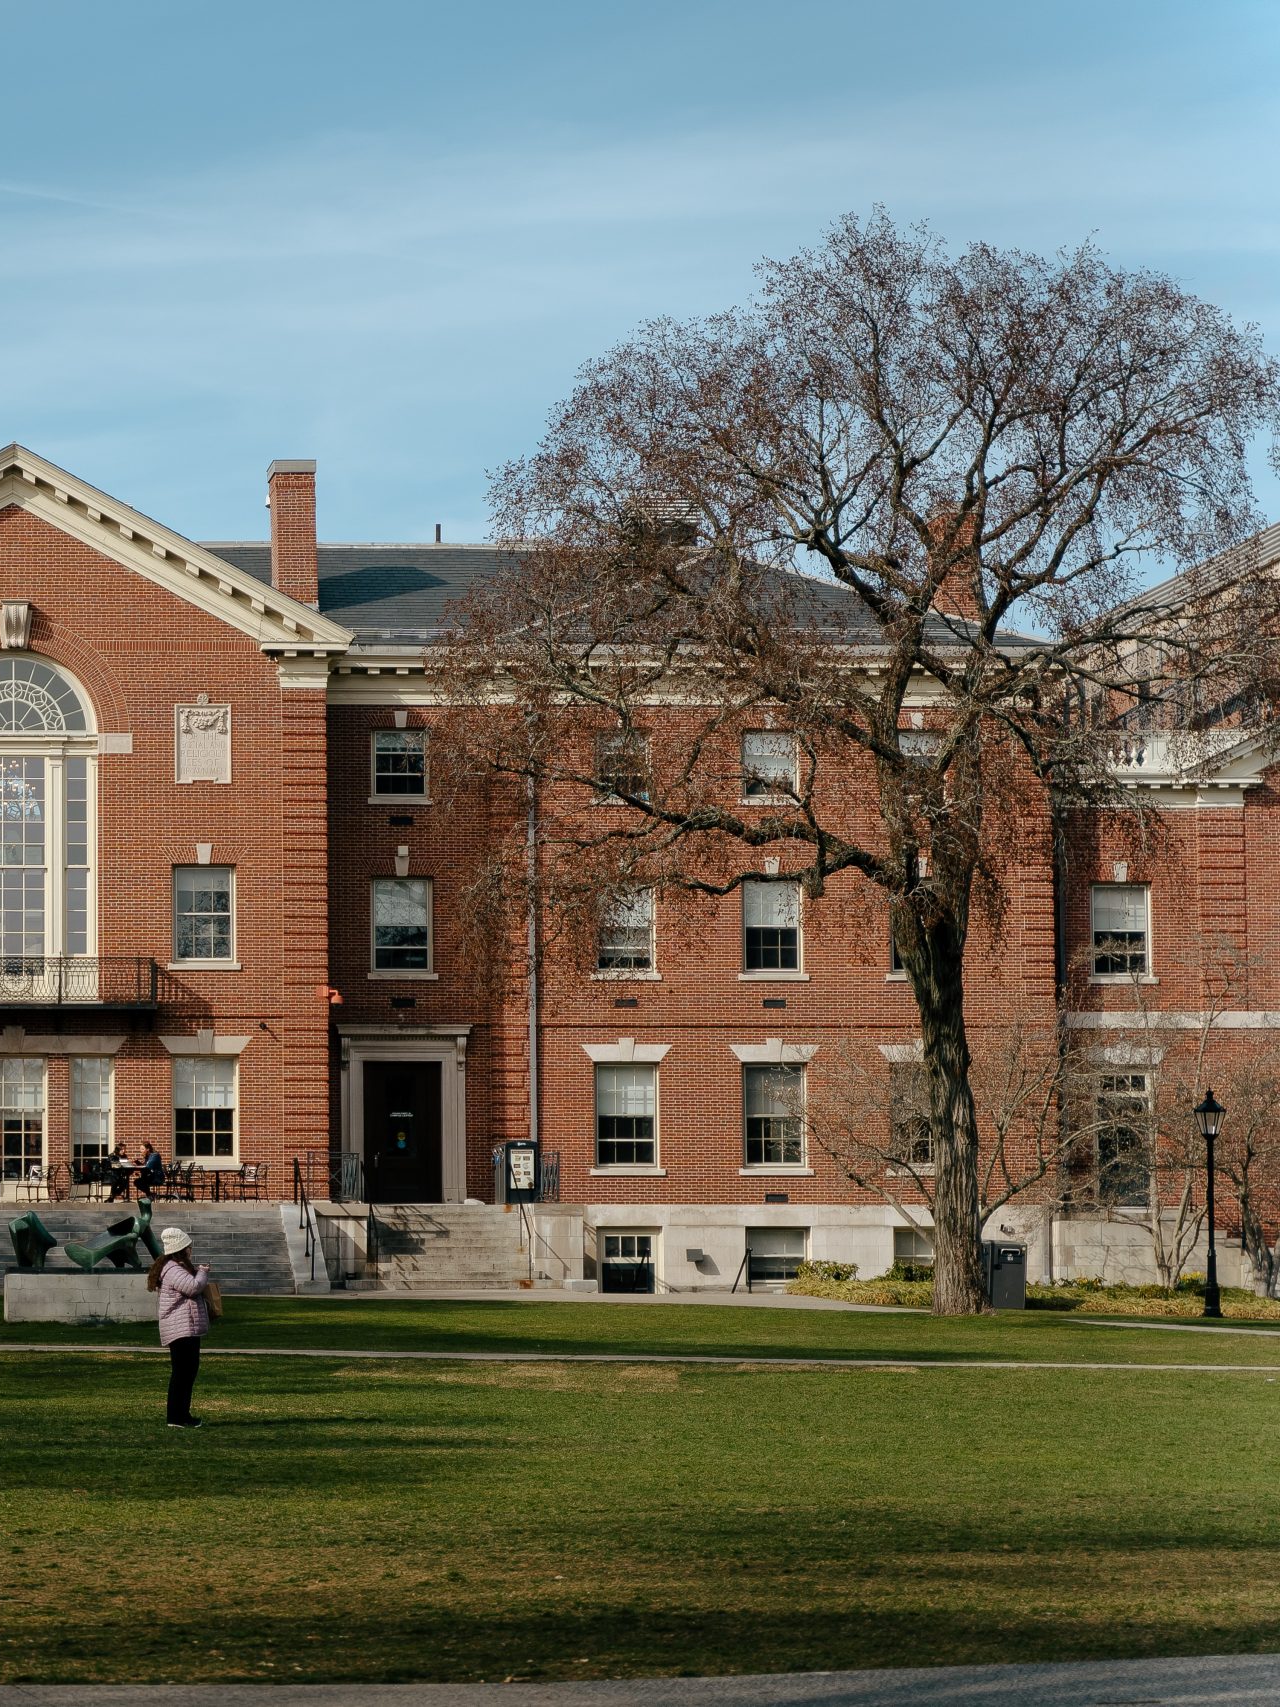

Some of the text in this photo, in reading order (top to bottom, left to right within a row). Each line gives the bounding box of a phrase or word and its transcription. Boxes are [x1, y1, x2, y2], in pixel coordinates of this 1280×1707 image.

[202, 732, 219, 740] THE
[209, 741, 226, 749] AND
[180, 749, 226, 757] RELIGIOUS
[206, 758, 220, 766] OF
